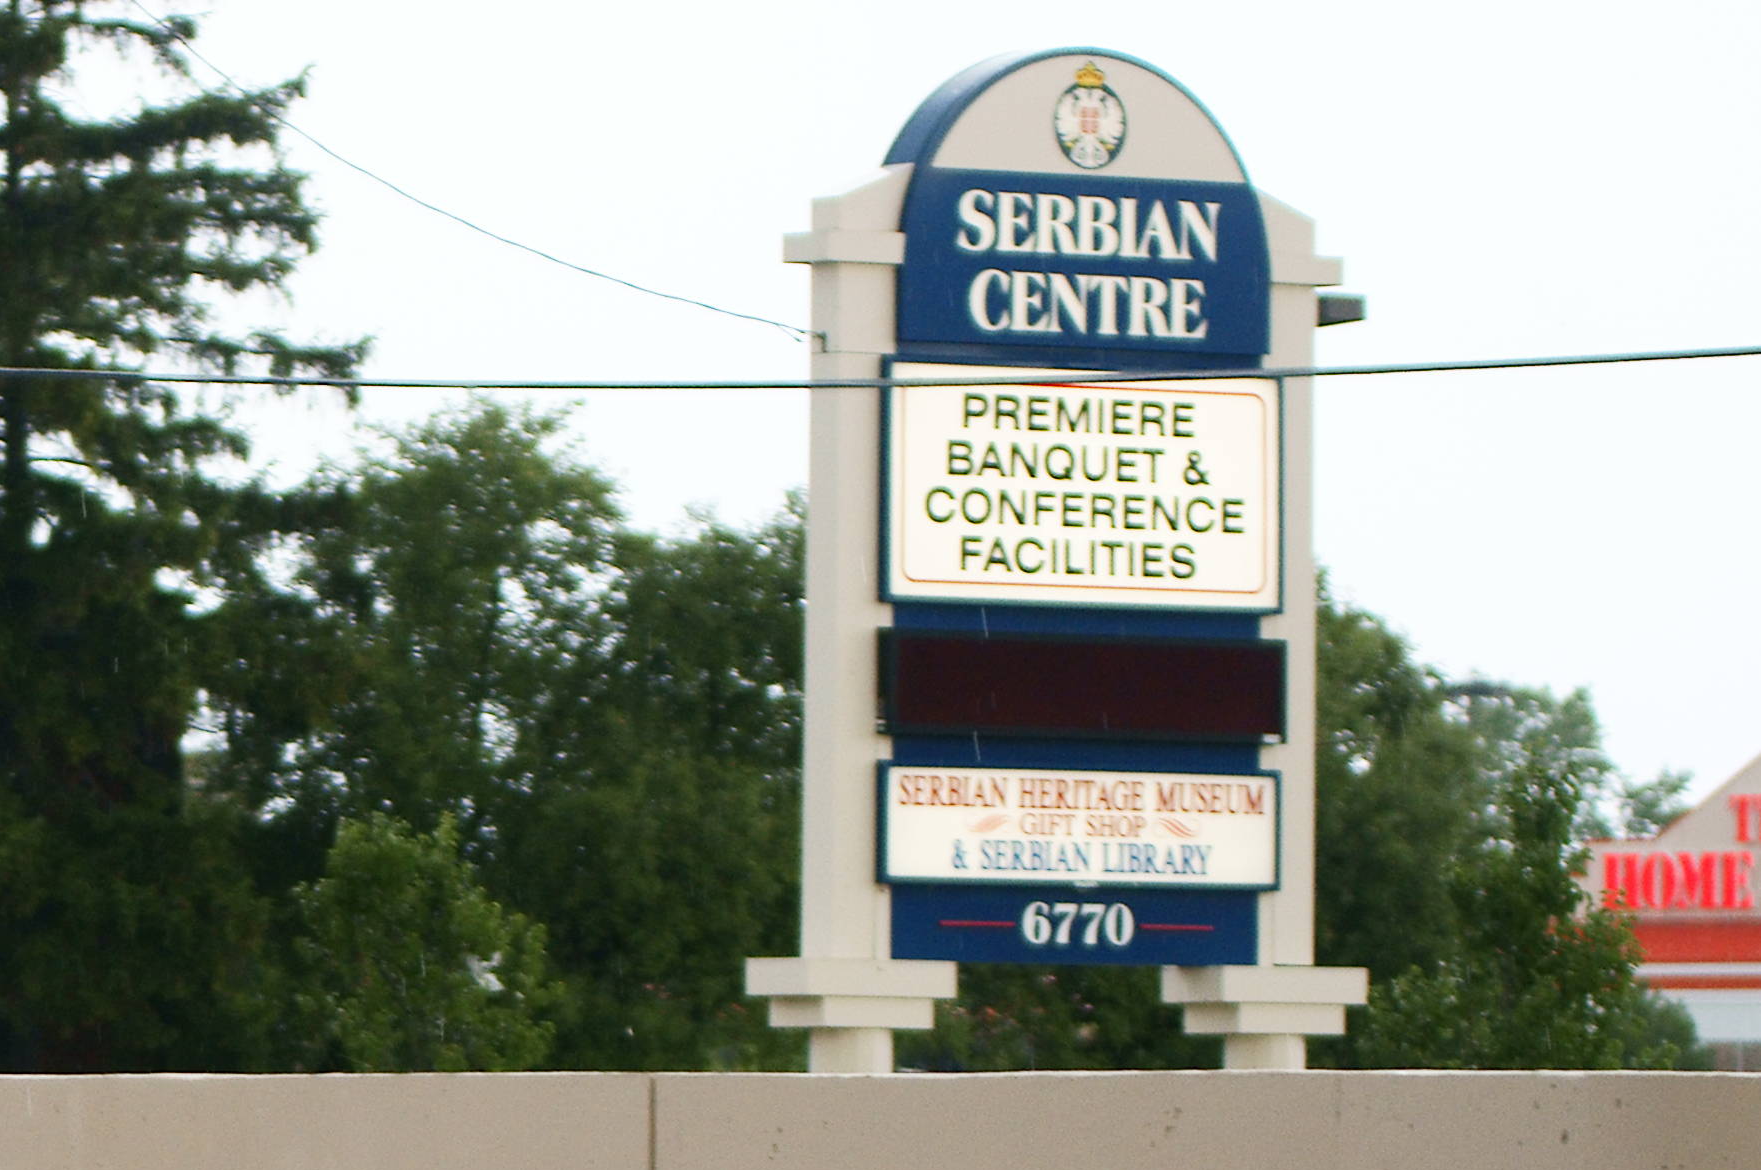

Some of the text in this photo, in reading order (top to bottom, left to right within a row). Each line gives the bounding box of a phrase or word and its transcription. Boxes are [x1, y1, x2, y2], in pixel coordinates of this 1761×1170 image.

[956, 189, 1221, 262] SERBIAN
[967, 268, 1209, 340] CENTRE
[962, 392, 1196, 438] PREMIERE
[947, 440, 1211, 486] BANQUET &
[925, 486, 1246, 534] CONFERENCE
[959, 535, 1198, 580] FACILITIES
[898, 774, 1266, 816] SERBIAN HERITAGE MUSEUM
[1019, 812, 1147, 838] GIFT SHOP
[950, 838, 1212, 876] & SERBIAN LIBRARY
[1603, 852, 1754, 910] HOME
[1021, 901, 1136, 947] 6770
